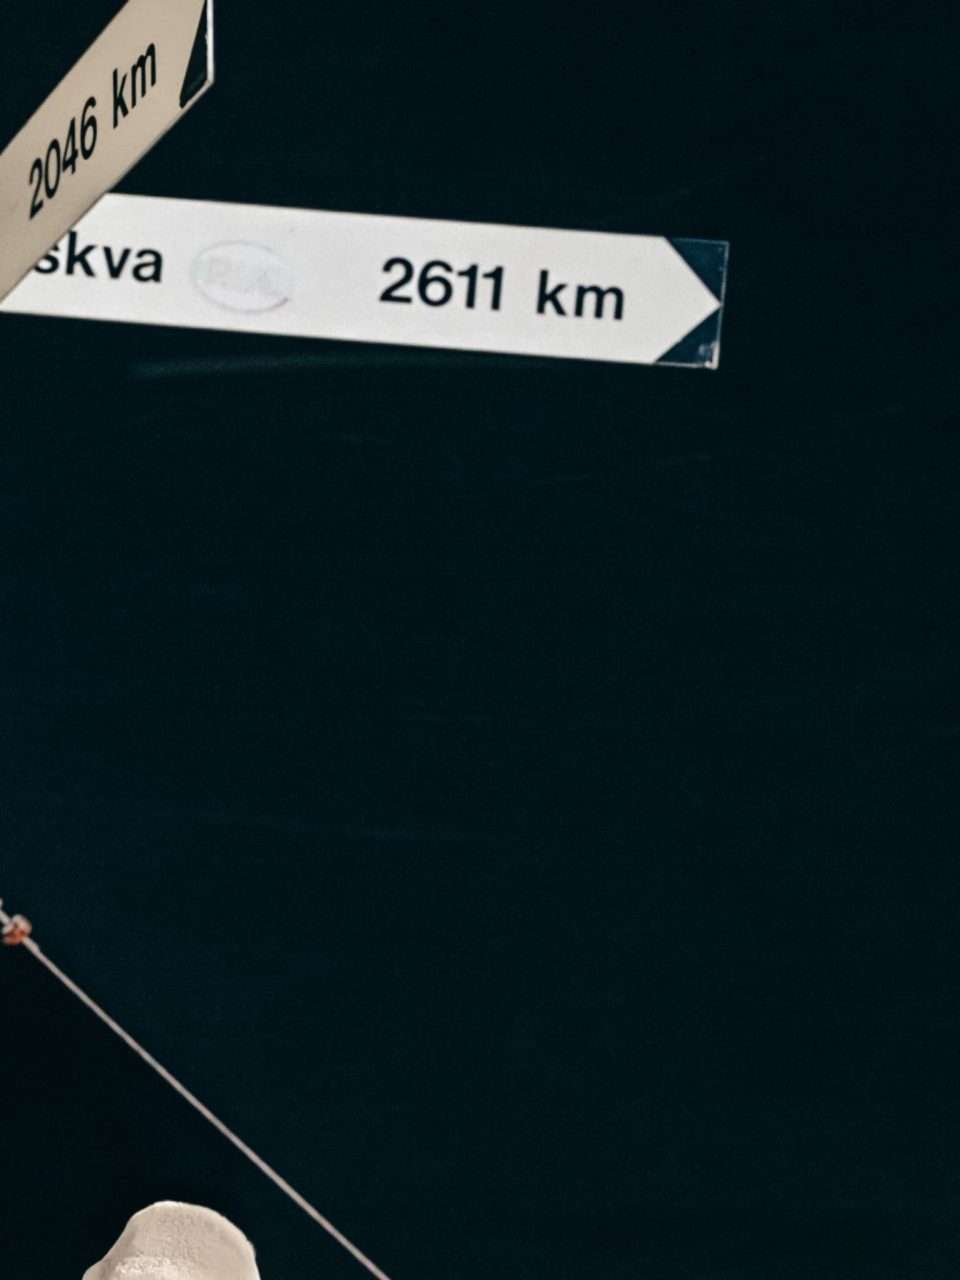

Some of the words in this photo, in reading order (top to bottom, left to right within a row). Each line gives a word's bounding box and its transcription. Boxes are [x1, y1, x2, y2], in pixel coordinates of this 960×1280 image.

[28, 96, 97, 220] 2046
[112, 42, 156, 129] km
[34, 230, 164, 283] skva
[379, 257, 504, 311] 2611
[536, 269, 624, 321] km
